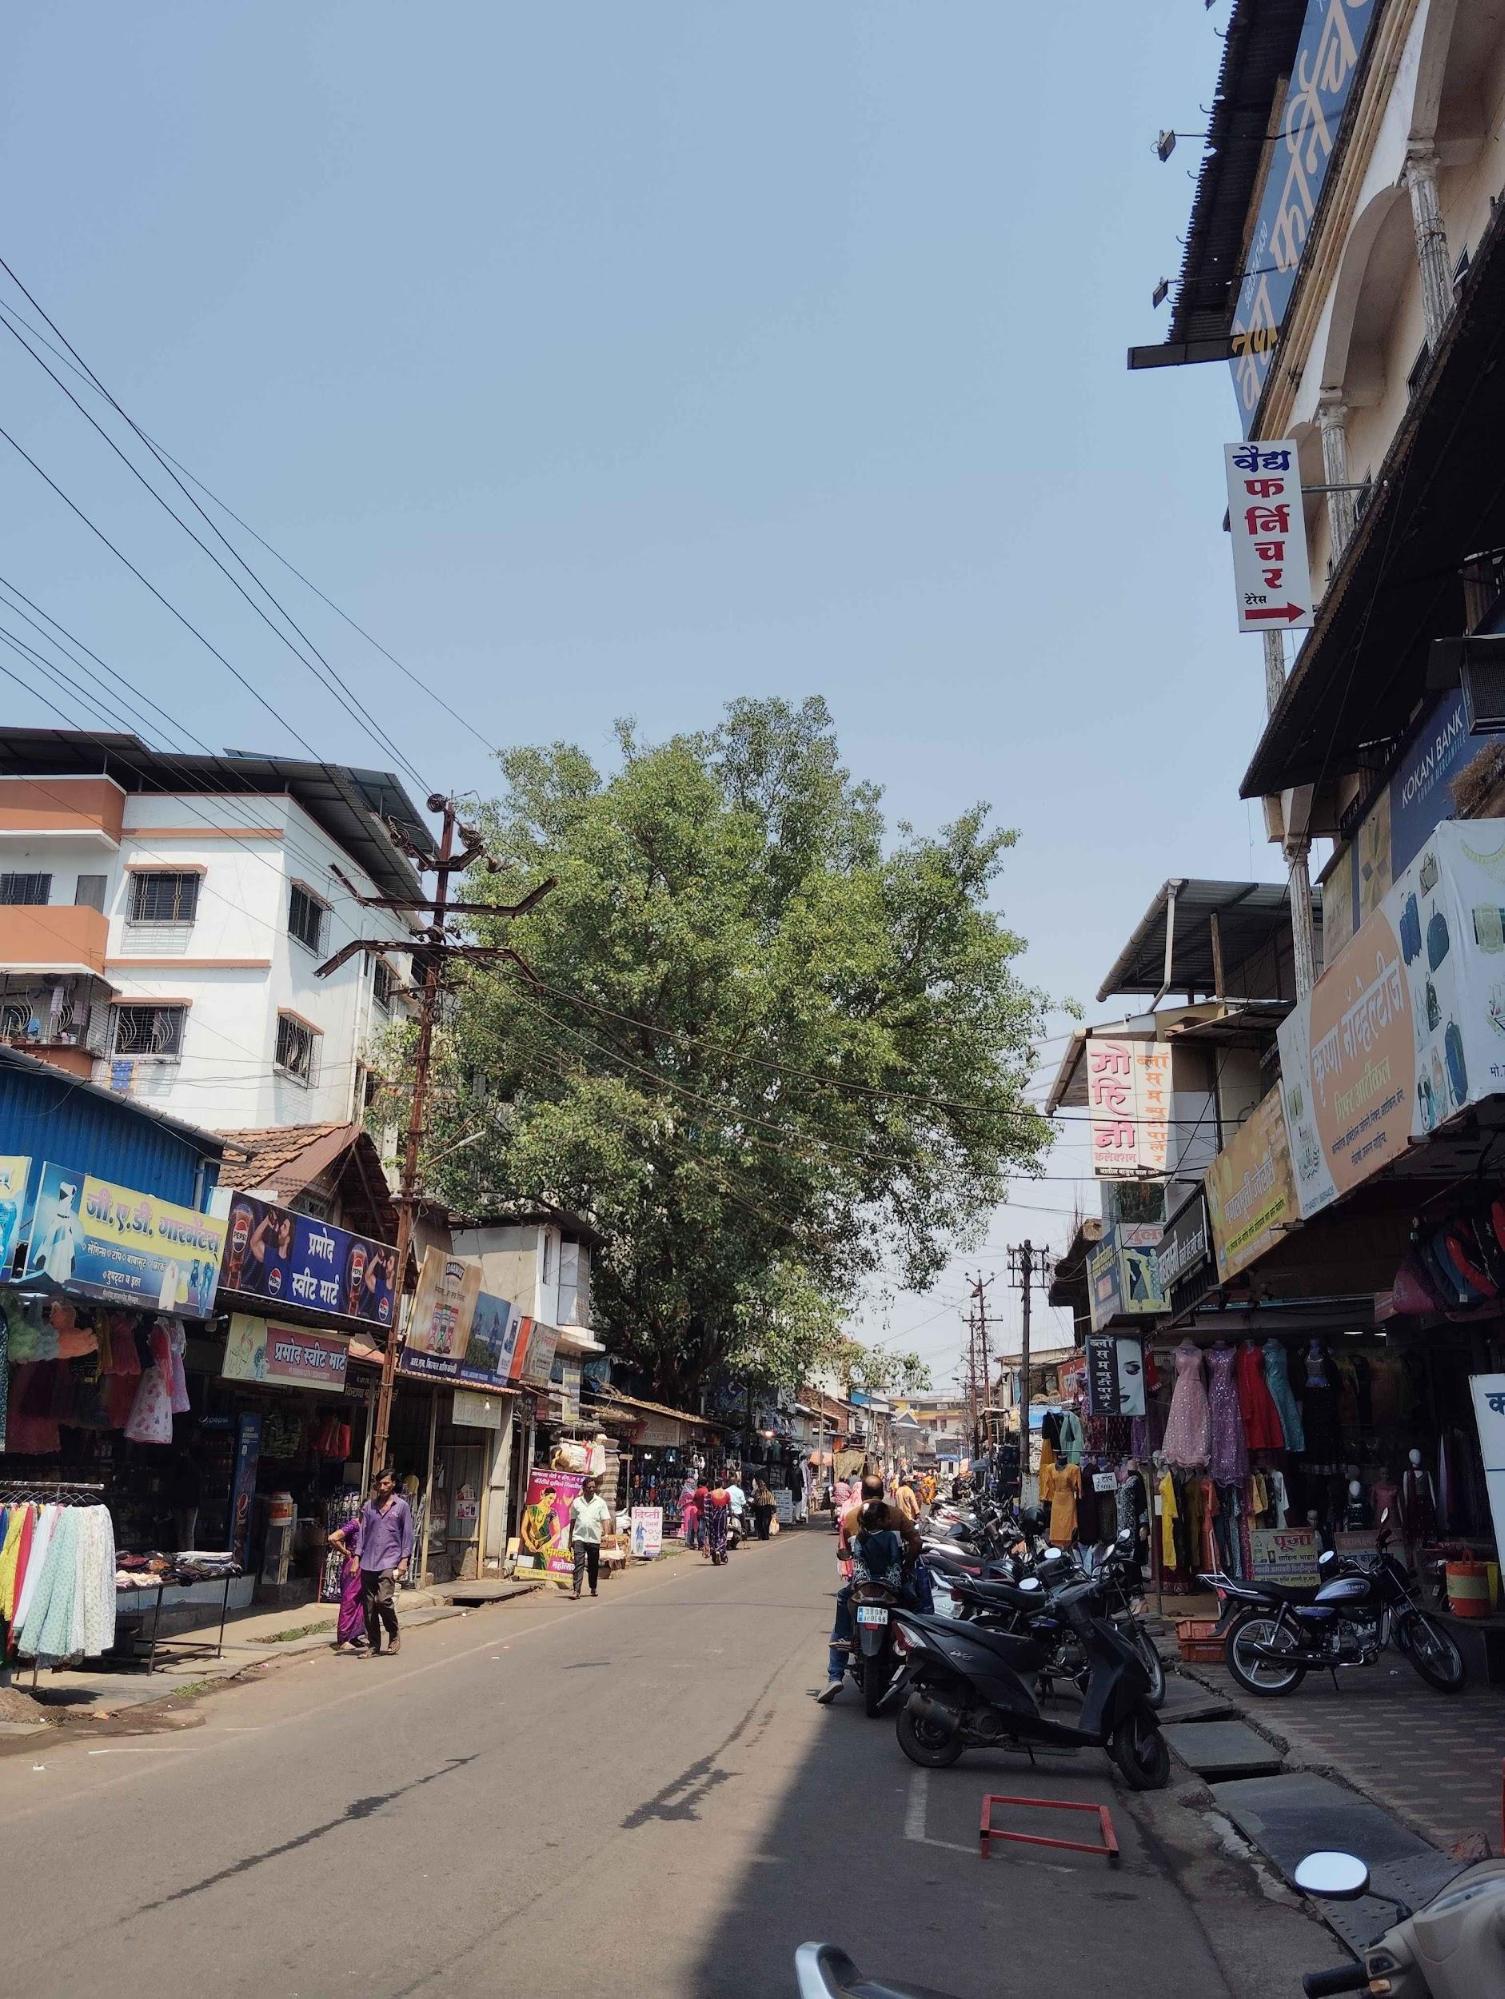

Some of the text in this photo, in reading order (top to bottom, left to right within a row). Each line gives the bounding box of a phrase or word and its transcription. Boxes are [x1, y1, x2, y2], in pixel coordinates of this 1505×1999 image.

[1232, 445, 1291, 472] वैद्य
[1244, 593, 1267, 605] टेरेस
[1402, 704, 1463, 808] KOKAN BANK
[307, 1227, 335, 1263] प्रमोद
[292, 1267, 340, 1306] स्वीट मार्ट
[274, 1338, 301, 1366] प्रमोद
[304, 1341, 326, 1367] स्वीट
